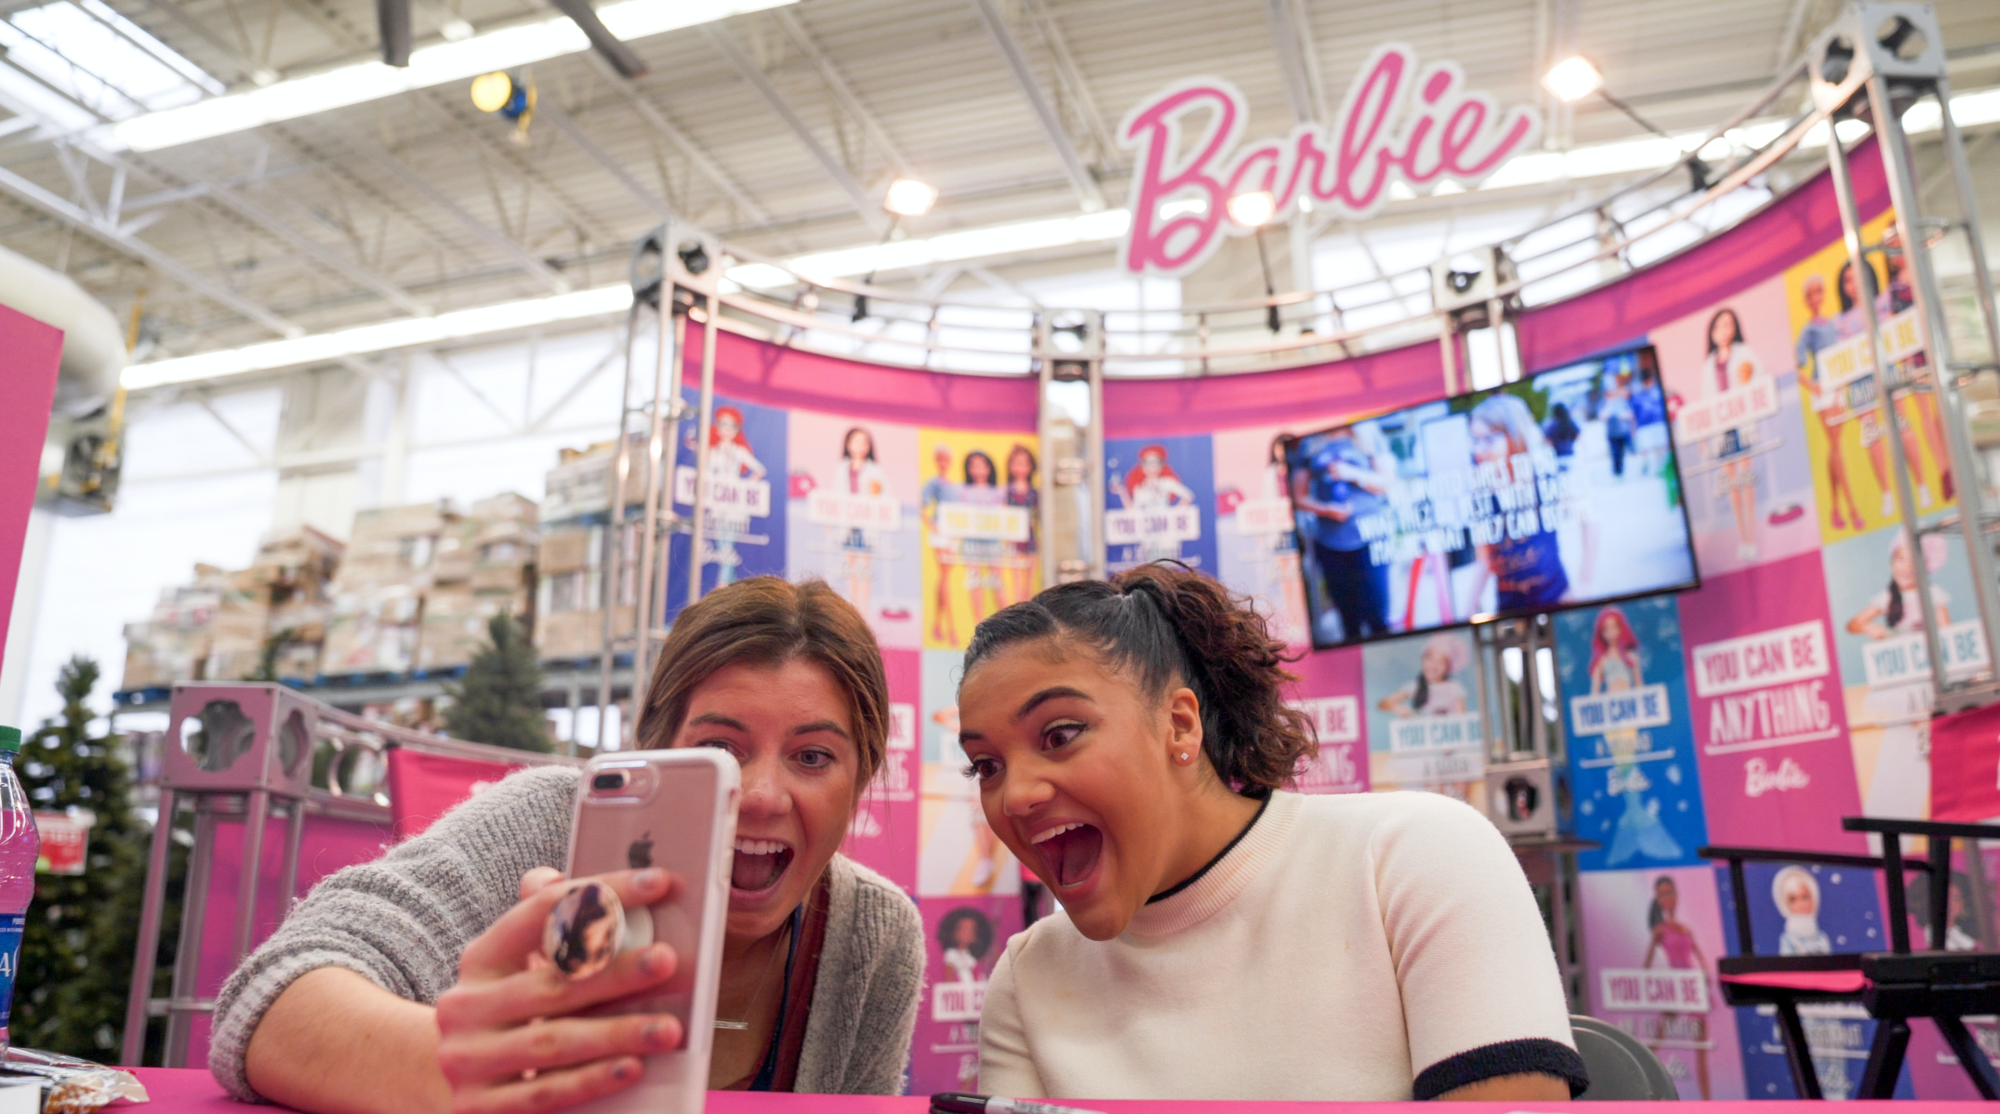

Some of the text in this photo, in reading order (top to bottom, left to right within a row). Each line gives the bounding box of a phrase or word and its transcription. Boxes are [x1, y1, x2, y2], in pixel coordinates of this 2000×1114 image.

[1125, 48, 1533, 273] Barbie
[1504, 507, 1541, 541] CAN
[1701, 631, 1817, 686] YOU CAN BE
[1873, 646, 1908, 679] YOU
[1954, 629, 1981, 663] BE
[1325, 704, 1348, 735] BE
[1579, 701, 1605, 726] YOU
[1709, 679, 1831, 745] ANYTHING
[1744, 756, 1812, 798] Barbie
[942, 990, 966, 1012] YOU
[1608, 976, 1640, 1002] YOU
[1644, 976, 1677, 1003] CAN
